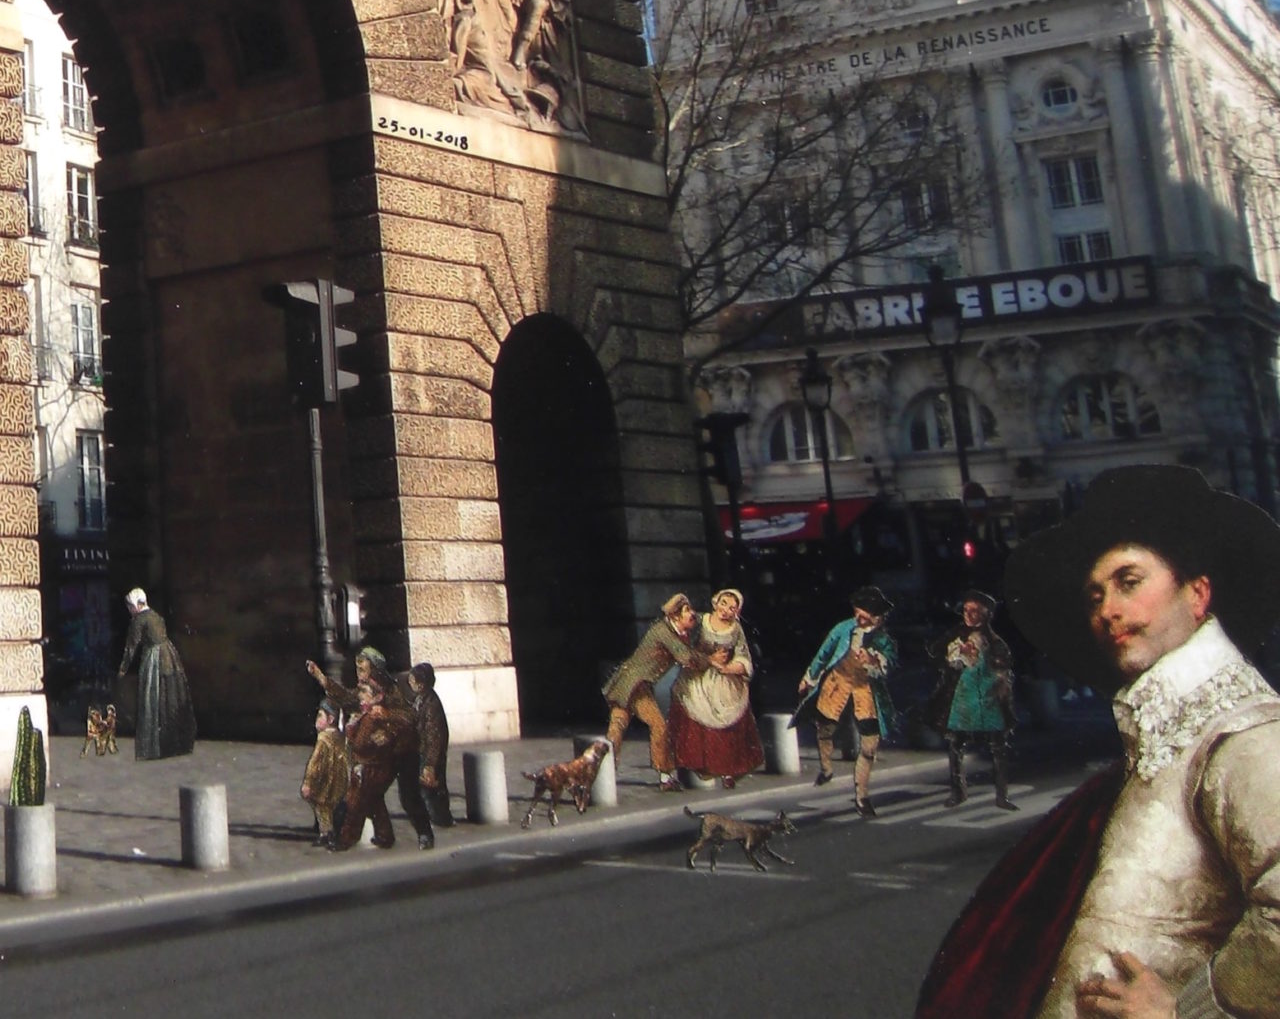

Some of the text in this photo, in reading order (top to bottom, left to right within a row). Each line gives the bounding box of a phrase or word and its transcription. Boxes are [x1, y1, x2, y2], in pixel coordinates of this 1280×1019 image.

[849, 51, 873, 68] DE
[883, 44, 906, 63] LA
[916, 17, 1051, 56] RENAISSANCE
[378, 116, 469, 151] 25-01-2018
[801, 264, 1152, 336] FABRIE EBOUE
